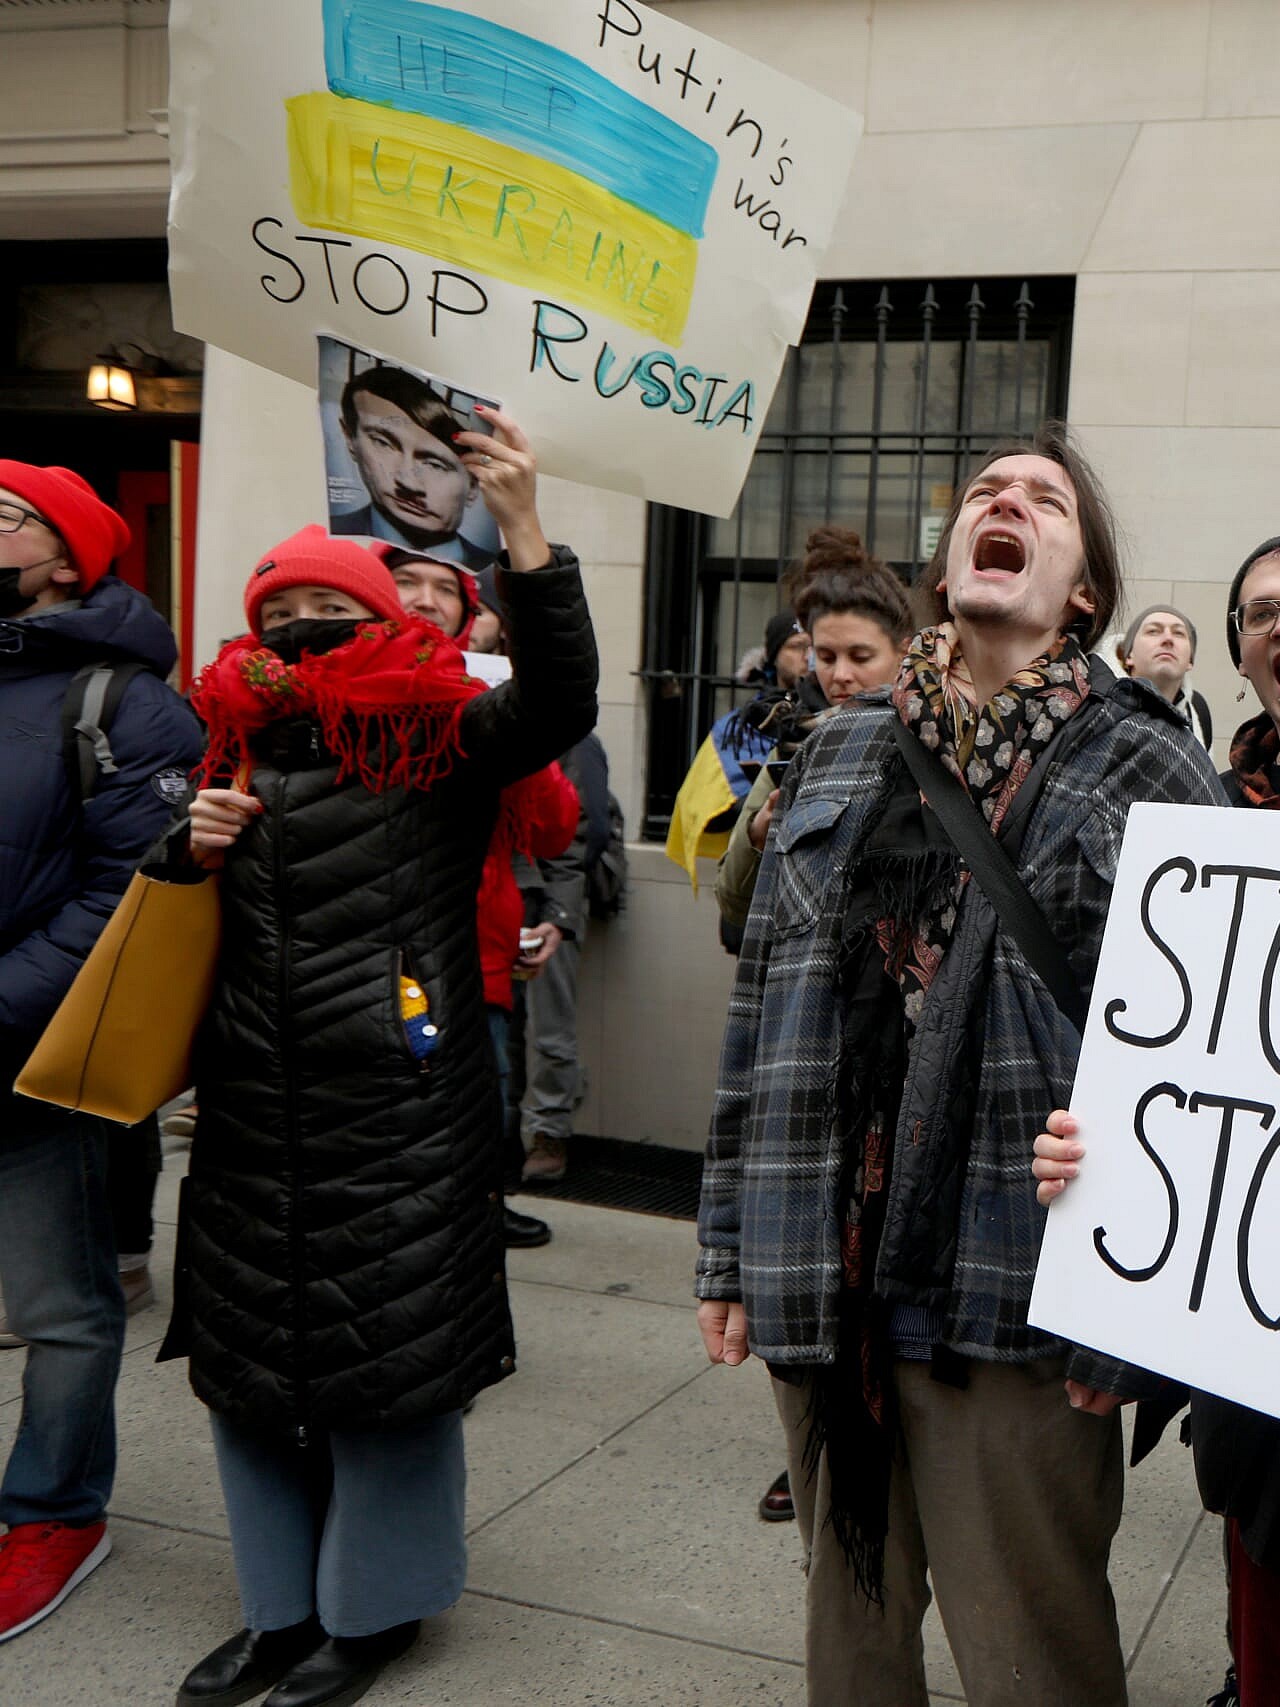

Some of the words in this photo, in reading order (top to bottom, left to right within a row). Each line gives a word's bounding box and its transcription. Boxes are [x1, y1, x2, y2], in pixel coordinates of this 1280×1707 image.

[396, 34, 578, 128] HELP
[597, 0, 793, 186] Putin's
[370, 137, 671, 319] UKRAINE
[733, 177, 807, 250] war
[251, 216, 489, 338] STOP
[529, 300, 755, 434] RUSSIA
